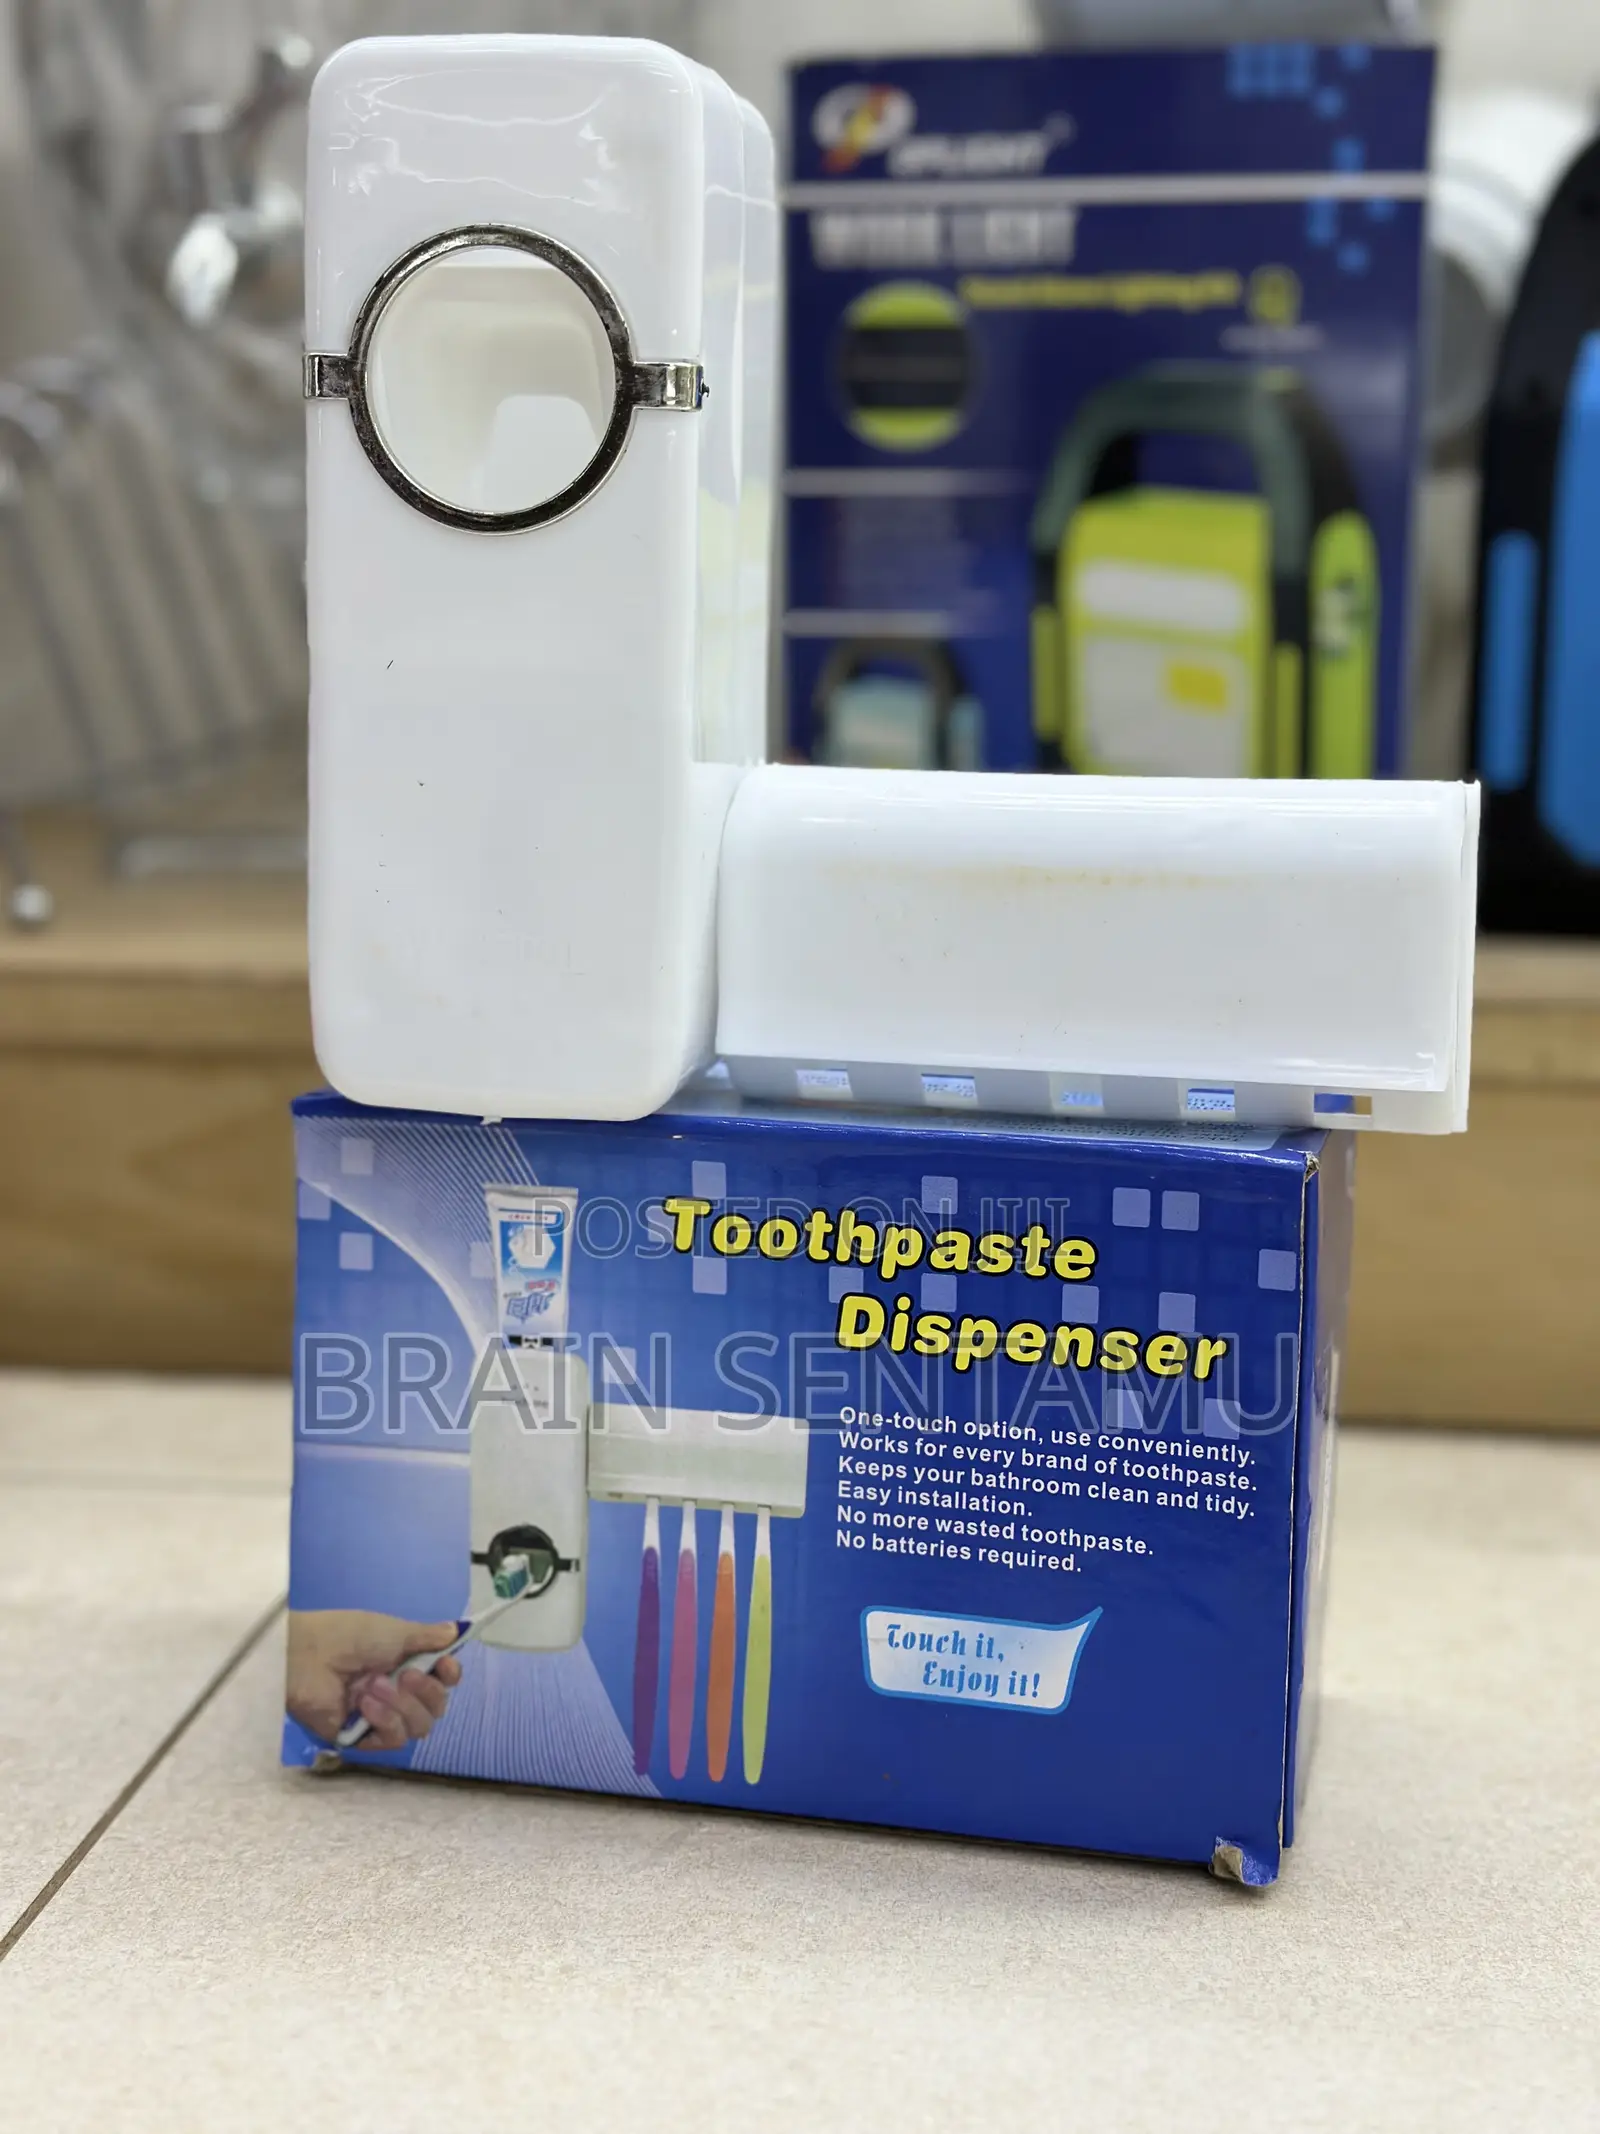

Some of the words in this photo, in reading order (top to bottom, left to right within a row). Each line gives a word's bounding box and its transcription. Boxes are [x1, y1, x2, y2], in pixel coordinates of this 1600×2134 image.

[661, 1195, 1098, 1282] Toothpaste
[835, 1292, 1230, 1382] Dispenser
[839, 1430, 909, 1454] Works
[915, 1438, 947, 1457] for
[952, 1444, 1015, 1468] every
[1021, 1448, 1087, 1472] brand
[1094, 1457, 1118, 1475] of
[1122, 1462, 1257, 1492] toothpaste.
[840, 1406, 957, 1434] One-touch
[963, 1420, 1043, 1445] option,
[1051, 1429, 1091, 1446] use
[1098, 1433, 1256, 1468] conveniently.
[838, 1455, 908, 1481] Keeps
[914, 1466, 965, 1484] your
[971, 1467, 1080, 1497] bathroom
[1087, 1481, 1149, 1503] clean
[1156, 1491, 1199, 1510] and
[1205, 1493, 1255, 1520] tidy.
[838, 1480, 891, 1505] Easy
[898, 1486, 1033, 1517] installation.
[836, 1529, 865, 1549] No
[872, 1533, 972, 1561] batteries
[978, 1547, 1082, 1573] required.
[837, 1505, 866, 1524] No
[873, 1511, 929, 1531] more
[935, 1517, 1015, 1541] wasted
[1021, 1523, 1154, 1556] toothpaste.
[887, 1623, 966, 1656] Touch
[975, 1632, 1004, 1663] it,
[922, 1660, 999, 1698] Enjoy
[1008, 1670, 1041, 1699] it!
